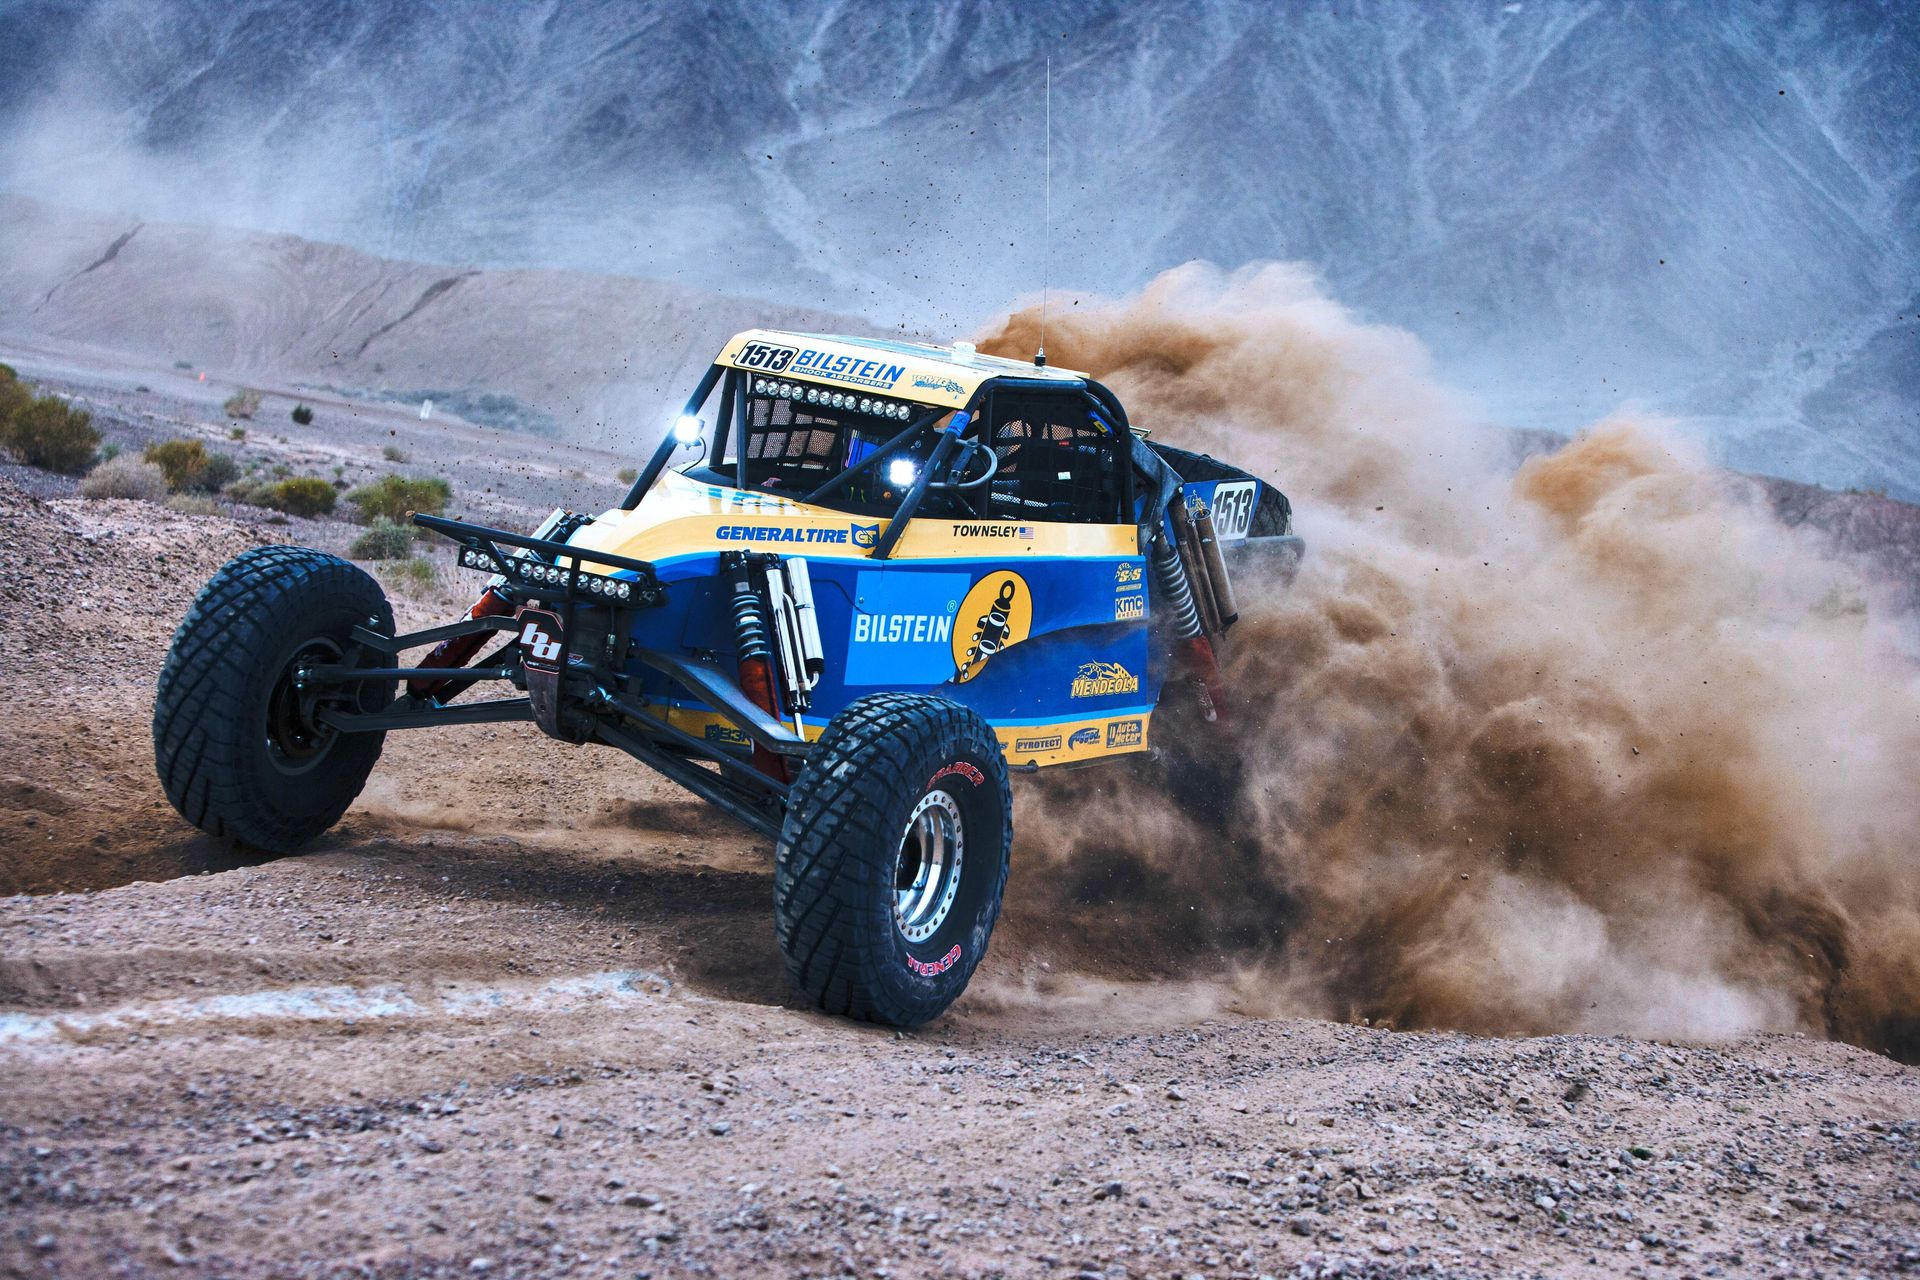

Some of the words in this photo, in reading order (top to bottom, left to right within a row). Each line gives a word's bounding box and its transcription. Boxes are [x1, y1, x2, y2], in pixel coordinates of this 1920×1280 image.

[739, 344, 794, 371] 1513
[795, 349, 906, 383] BILSTEIN
[793, 366, 828, 378] SHOCK
[829, 373, 891, 389] ABSORBERS
[1213, 488, 1254, 536] 1513
[952, 525, 1018, 538] TOWNSLEY
[854, 614, 952, 643] BILSTEIN
[1071, 675, 1139, 699] MENDEOLA
[1017, 739, 1060, 750] PYROTECT
